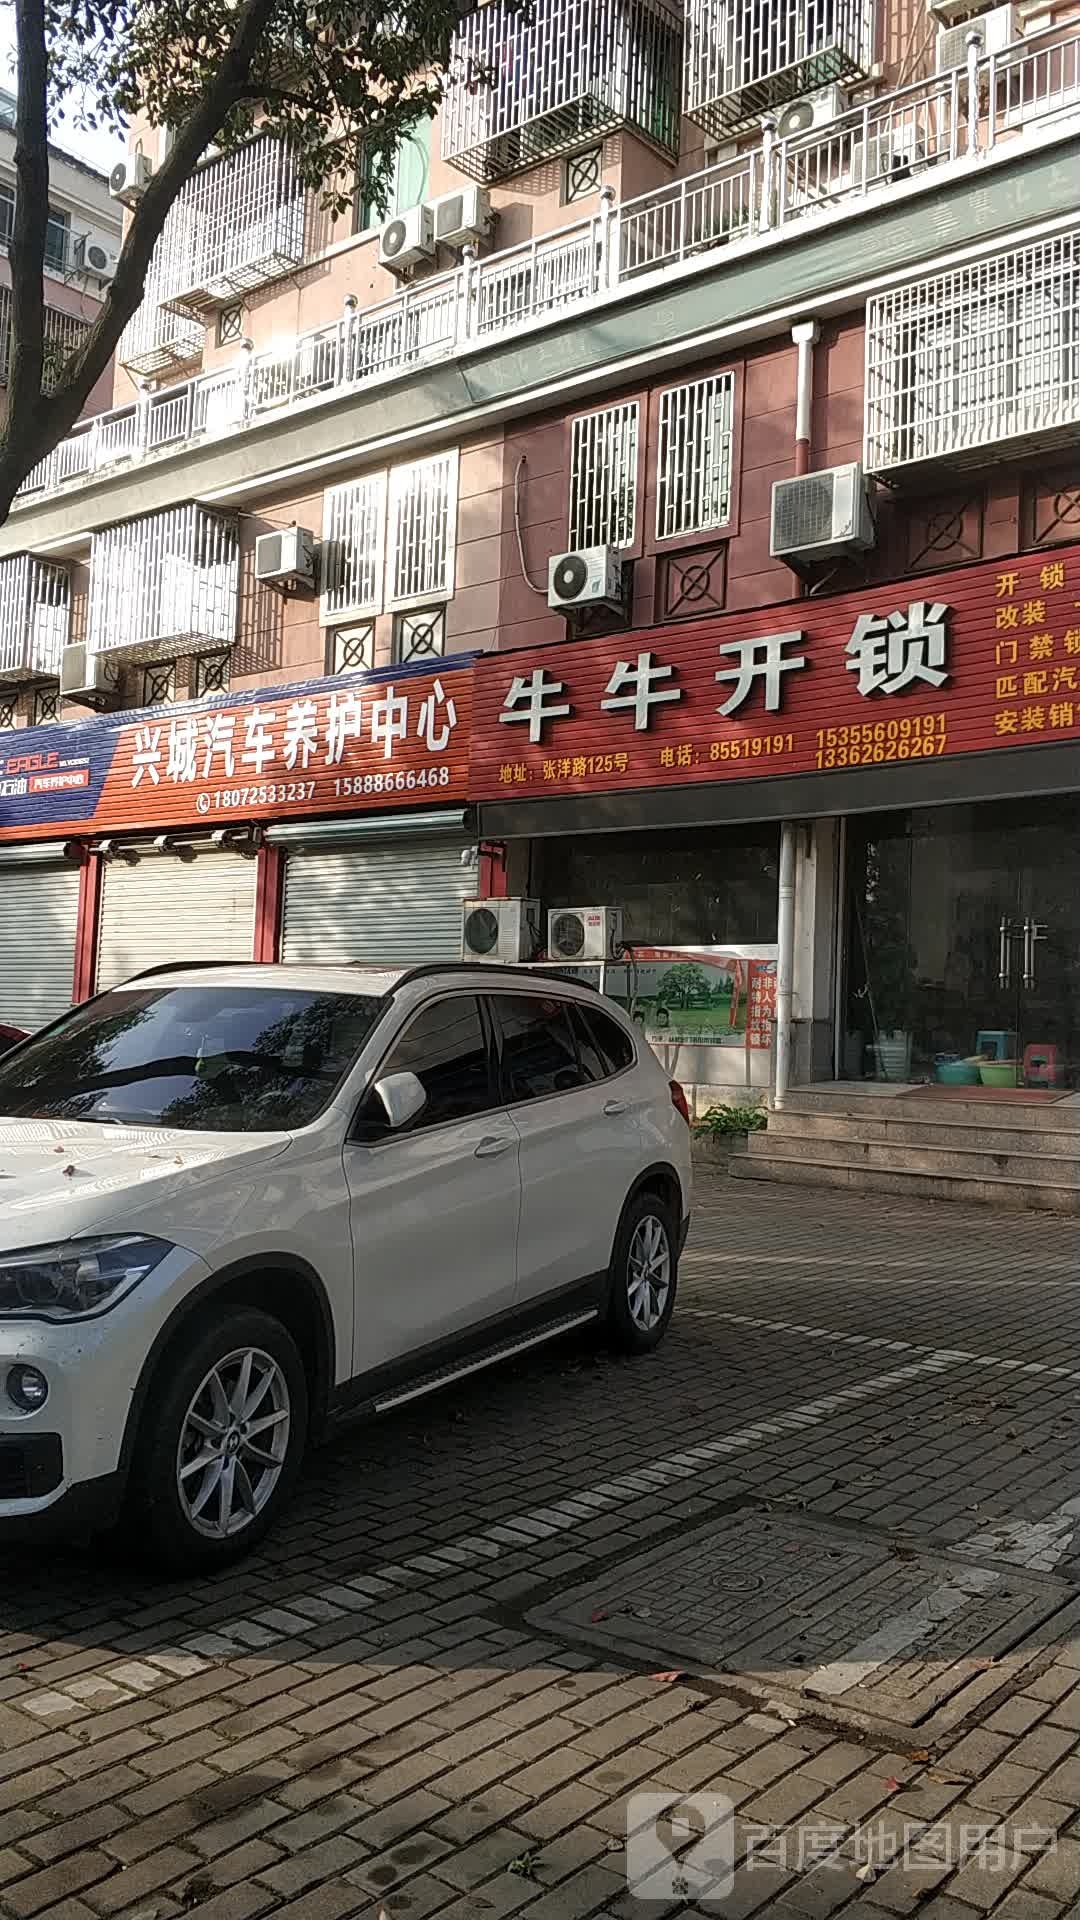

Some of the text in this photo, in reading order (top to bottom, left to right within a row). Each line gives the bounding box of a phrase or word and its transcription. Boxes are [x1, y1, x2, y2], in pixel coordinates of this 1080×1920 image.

[995, 600, 1046, 629] 改装
[499, 602, 949, 742] 牛牛开锁
[996, 666, 1077, 699] 匹配汽
[131, 679, 457, 788] 兴城汽车养护中心
[816, 713, 946, 748] 15355609191
[994, 702, 1080, 735] 安装销
[6, 752, 60, 774] EAGLE
[815, 735, 946, 769] 13362626267
[213, 782, 316, 808] 18072533237
[334, 767, 449, 797] 15888666468
